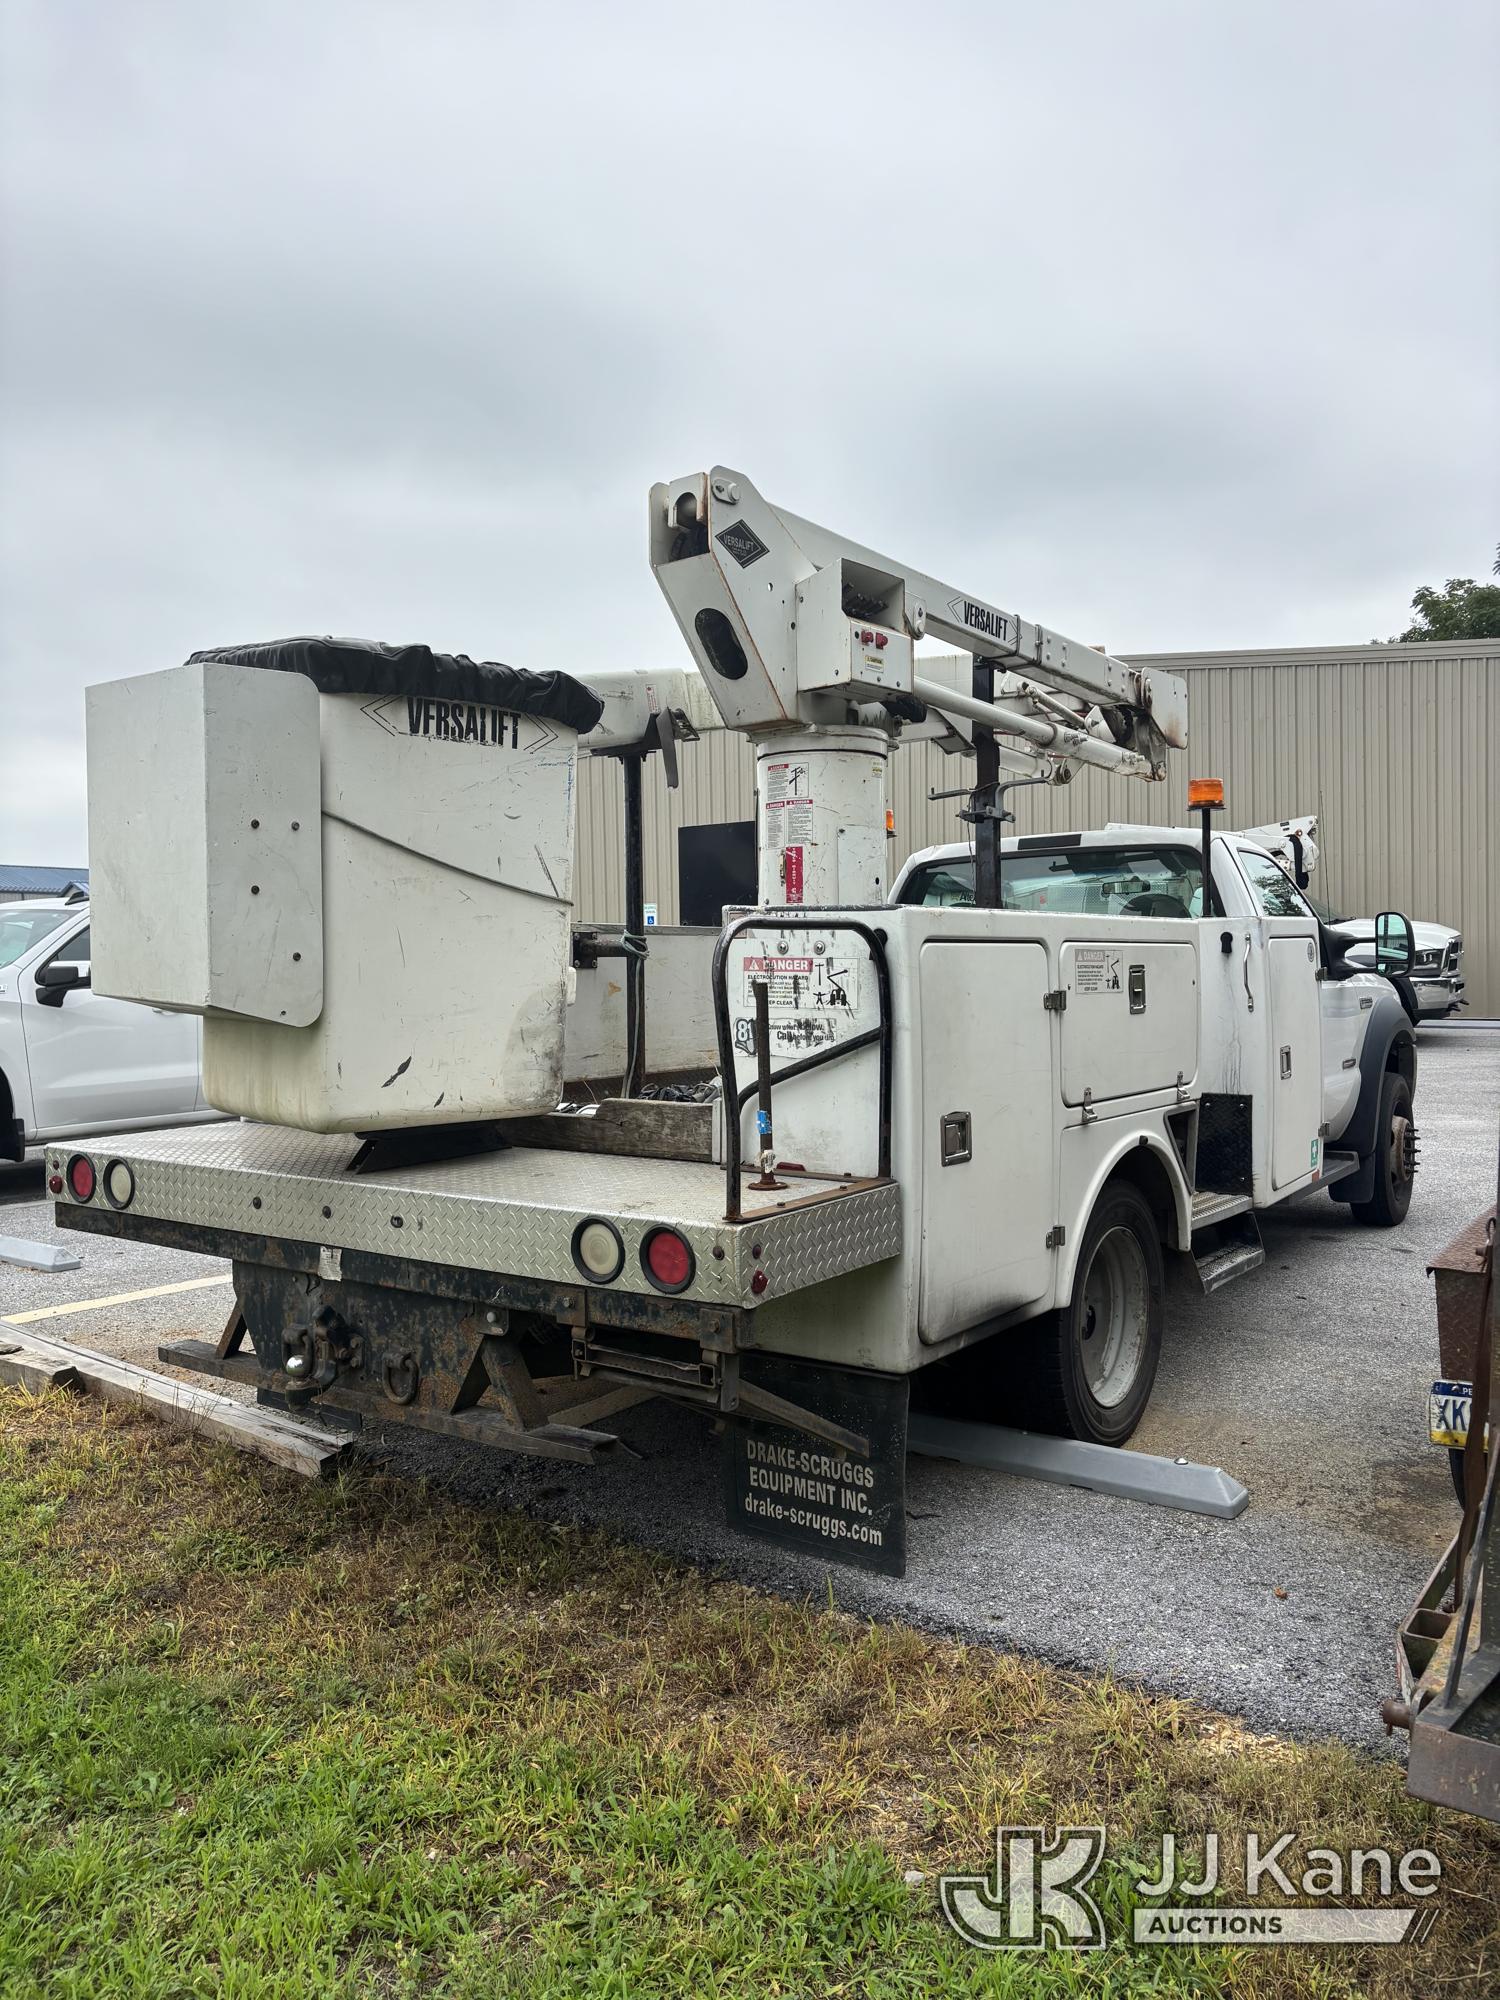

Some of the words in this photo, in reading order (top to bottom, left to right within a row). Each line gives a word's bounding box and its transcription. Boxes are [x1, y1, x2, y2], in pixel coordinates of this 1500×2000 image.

[723, 533, 755, 552] VERSALIFT
[963, 600, 1009, 641] VERSALIFT
[762, 959, 808, 970] DANGER
[1435, 1398, 1473, 1431] XK
[746, 1439, 874, 1488] DRAKE-SCRUGGS
[749, 1466, 836, 1506] EQUIPMENT
[840, 1488, 873, 1516] INC.
[744, 1493, 882, 1546] drake-scruggs.com
